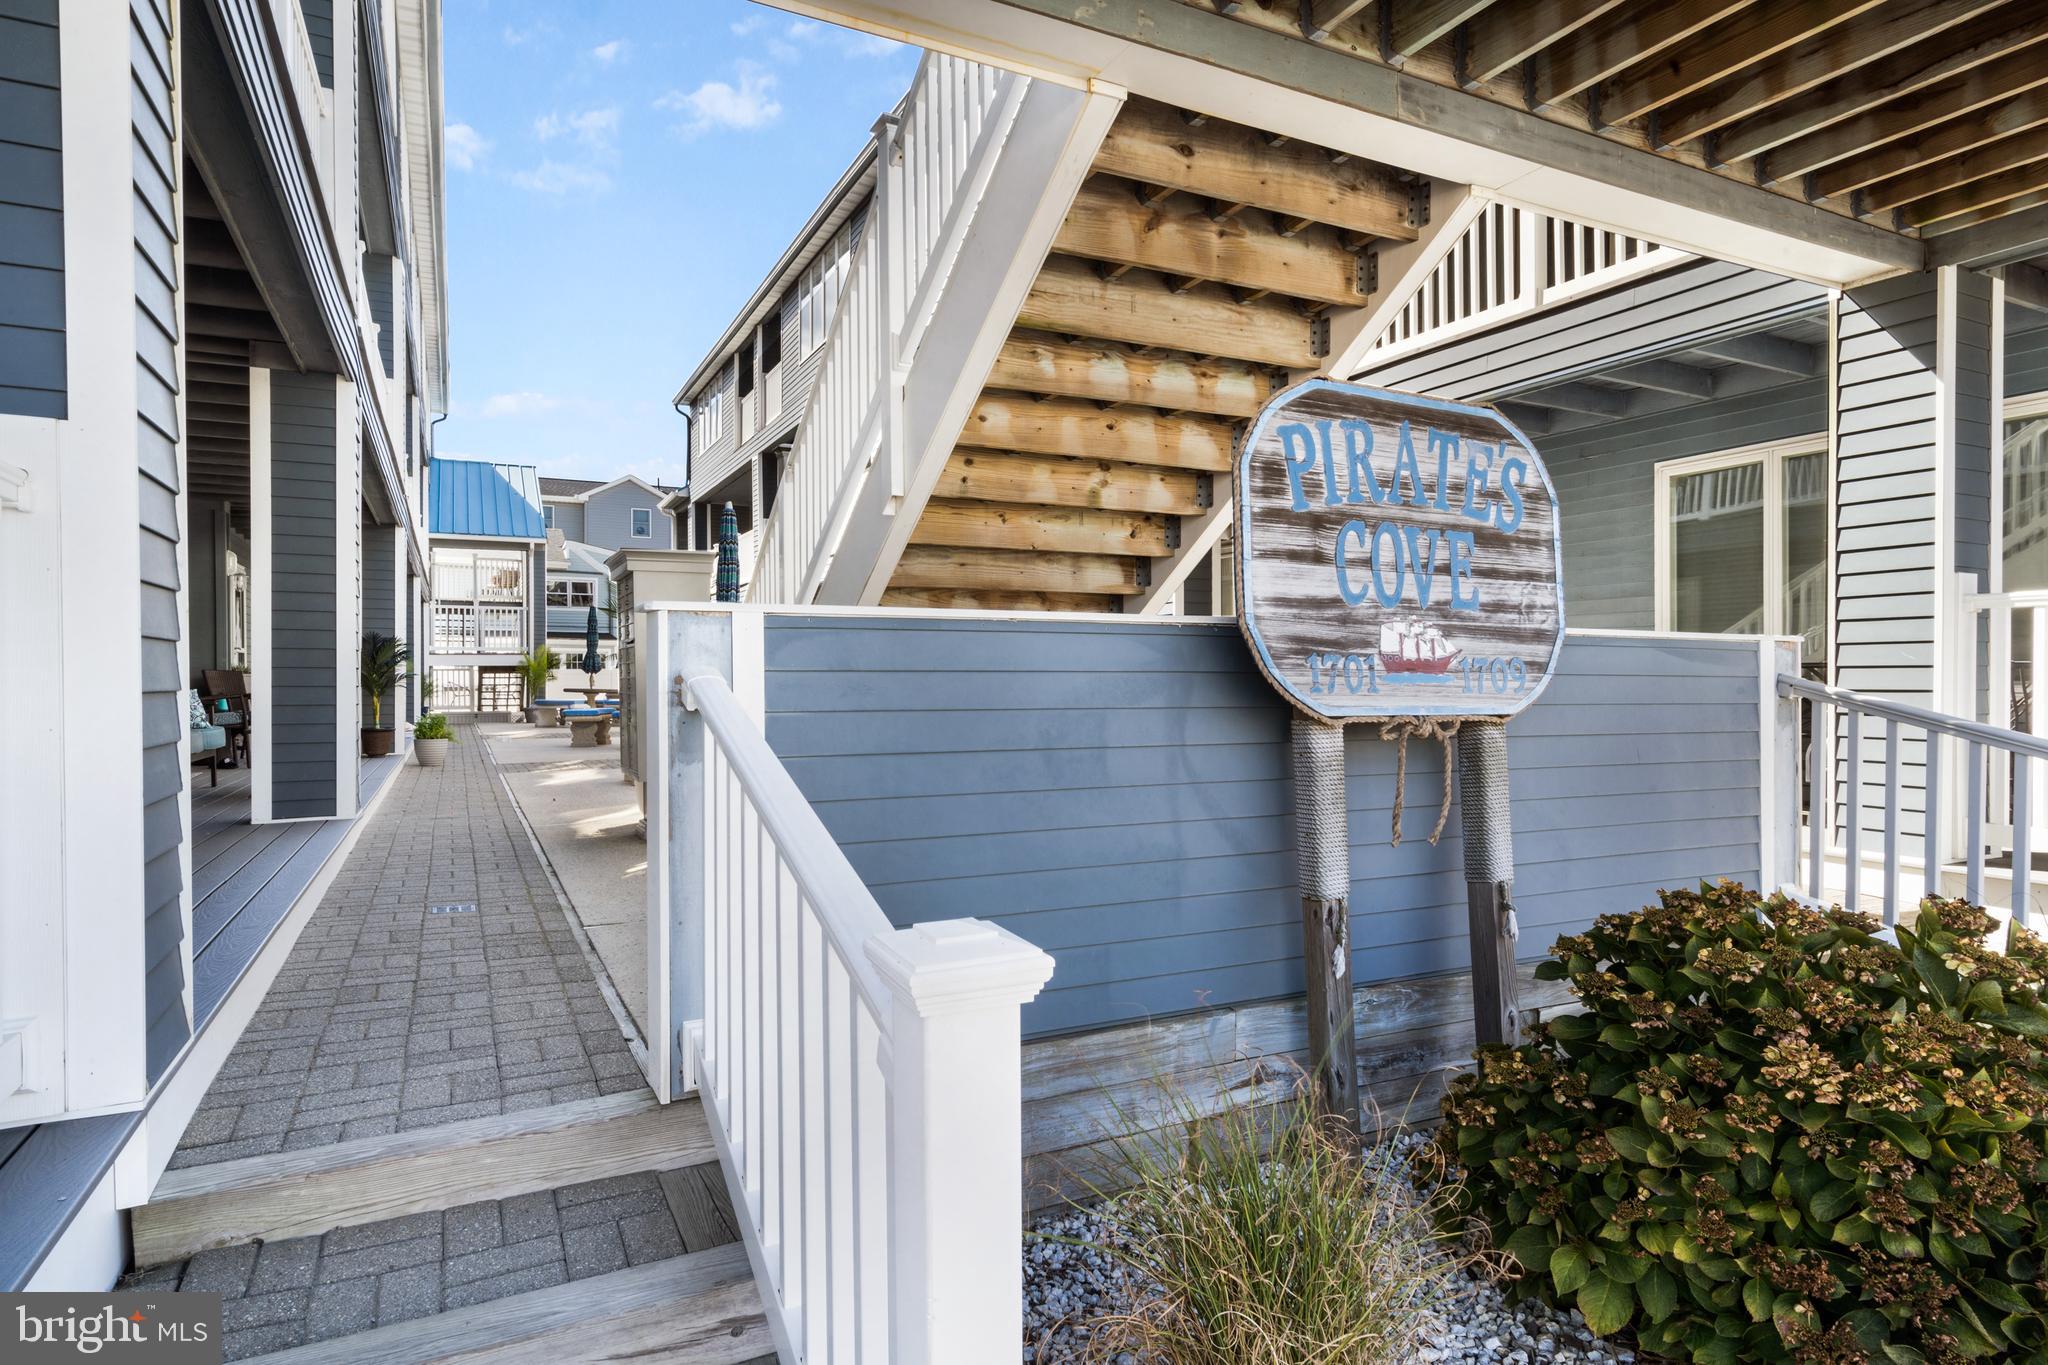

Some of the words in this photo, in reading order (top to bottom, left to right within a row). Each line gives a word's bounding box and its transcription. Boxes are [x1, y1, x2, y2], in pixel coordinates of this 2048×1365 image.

[1276, 420, 1528, 533] PIRATE'S
[1335, 519, 1480, 611] COVE
[1305, 652, 1381, 694] 1701
[1458, 656, 1527, 694] 1709
